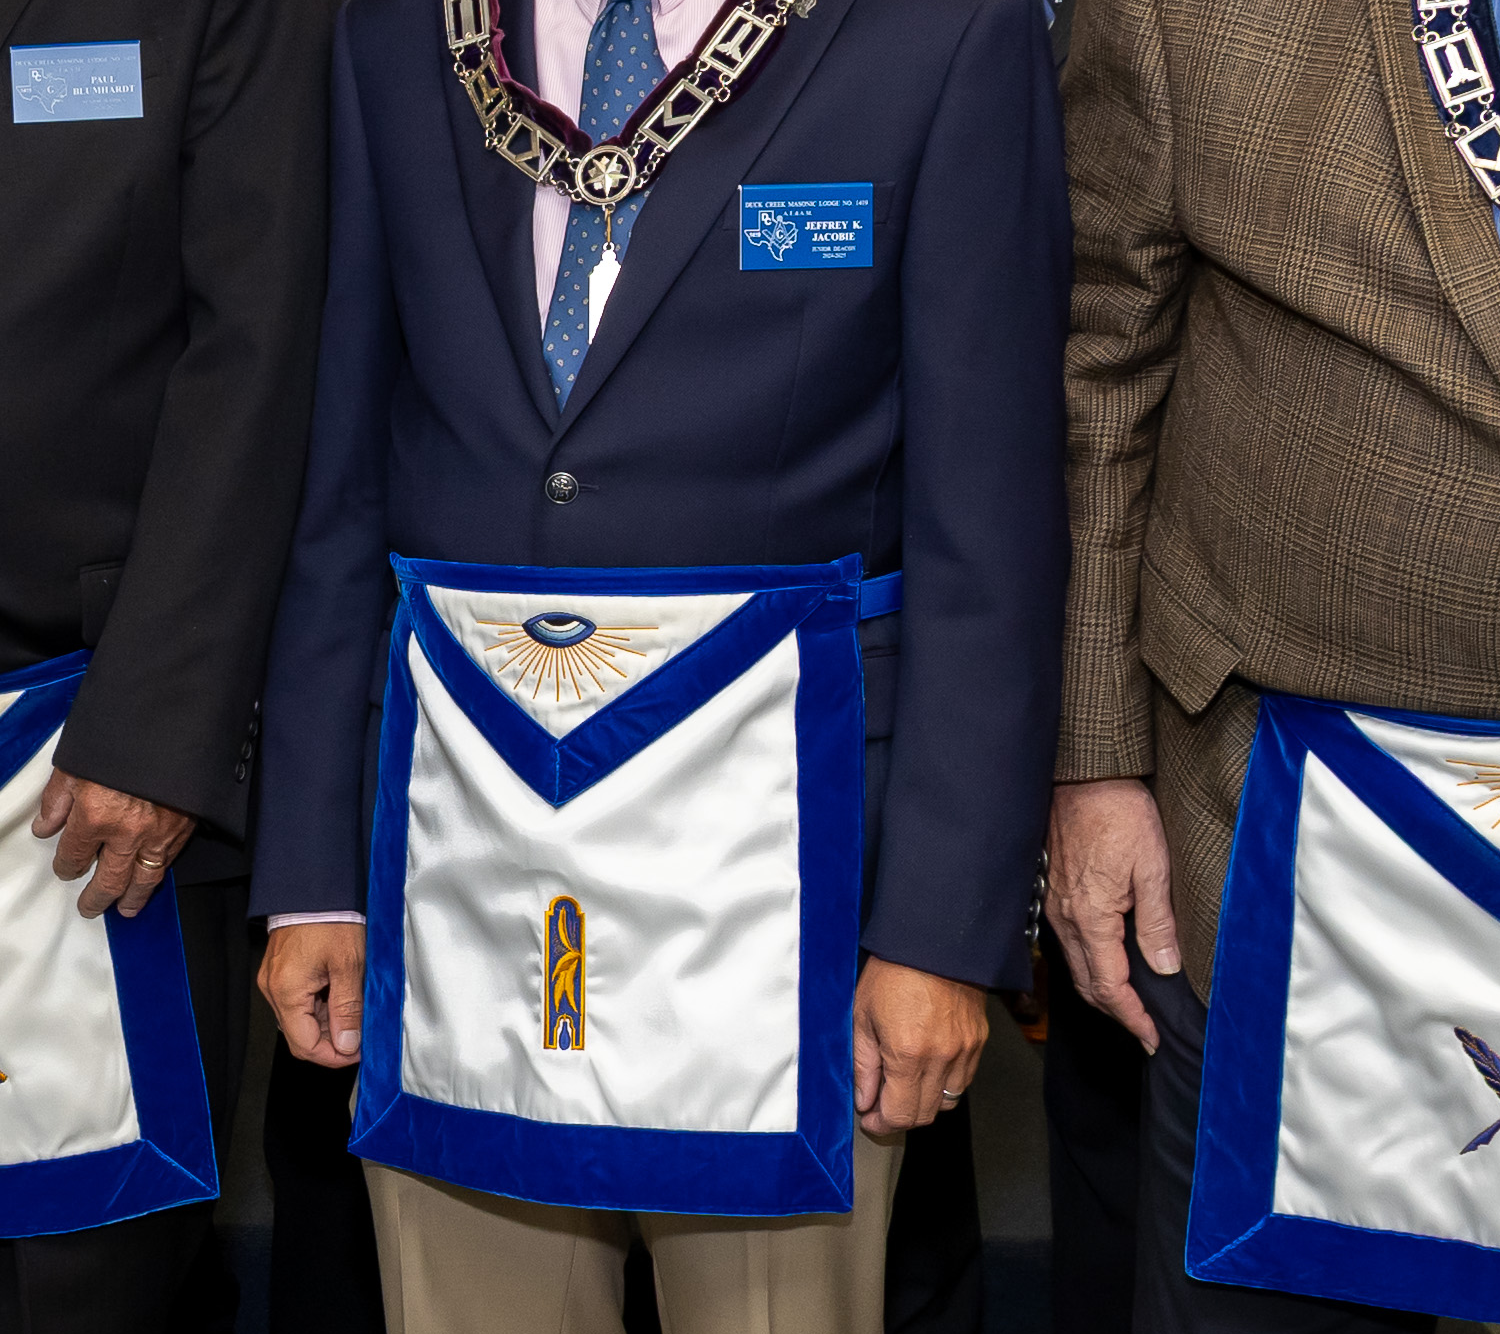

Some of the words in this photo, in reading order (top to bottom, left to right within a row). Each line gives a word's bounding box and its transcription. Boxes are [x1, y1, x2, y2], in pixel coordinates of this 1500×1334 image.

[90, 75, 117, 84] PAUL
[72, 84, 136, 96] BLUMHARDT
[805, 220, 848, 230] JEFFREY
[853, 220, 863, 229] K.
[812, 232, 855, 241] JACOBIE
